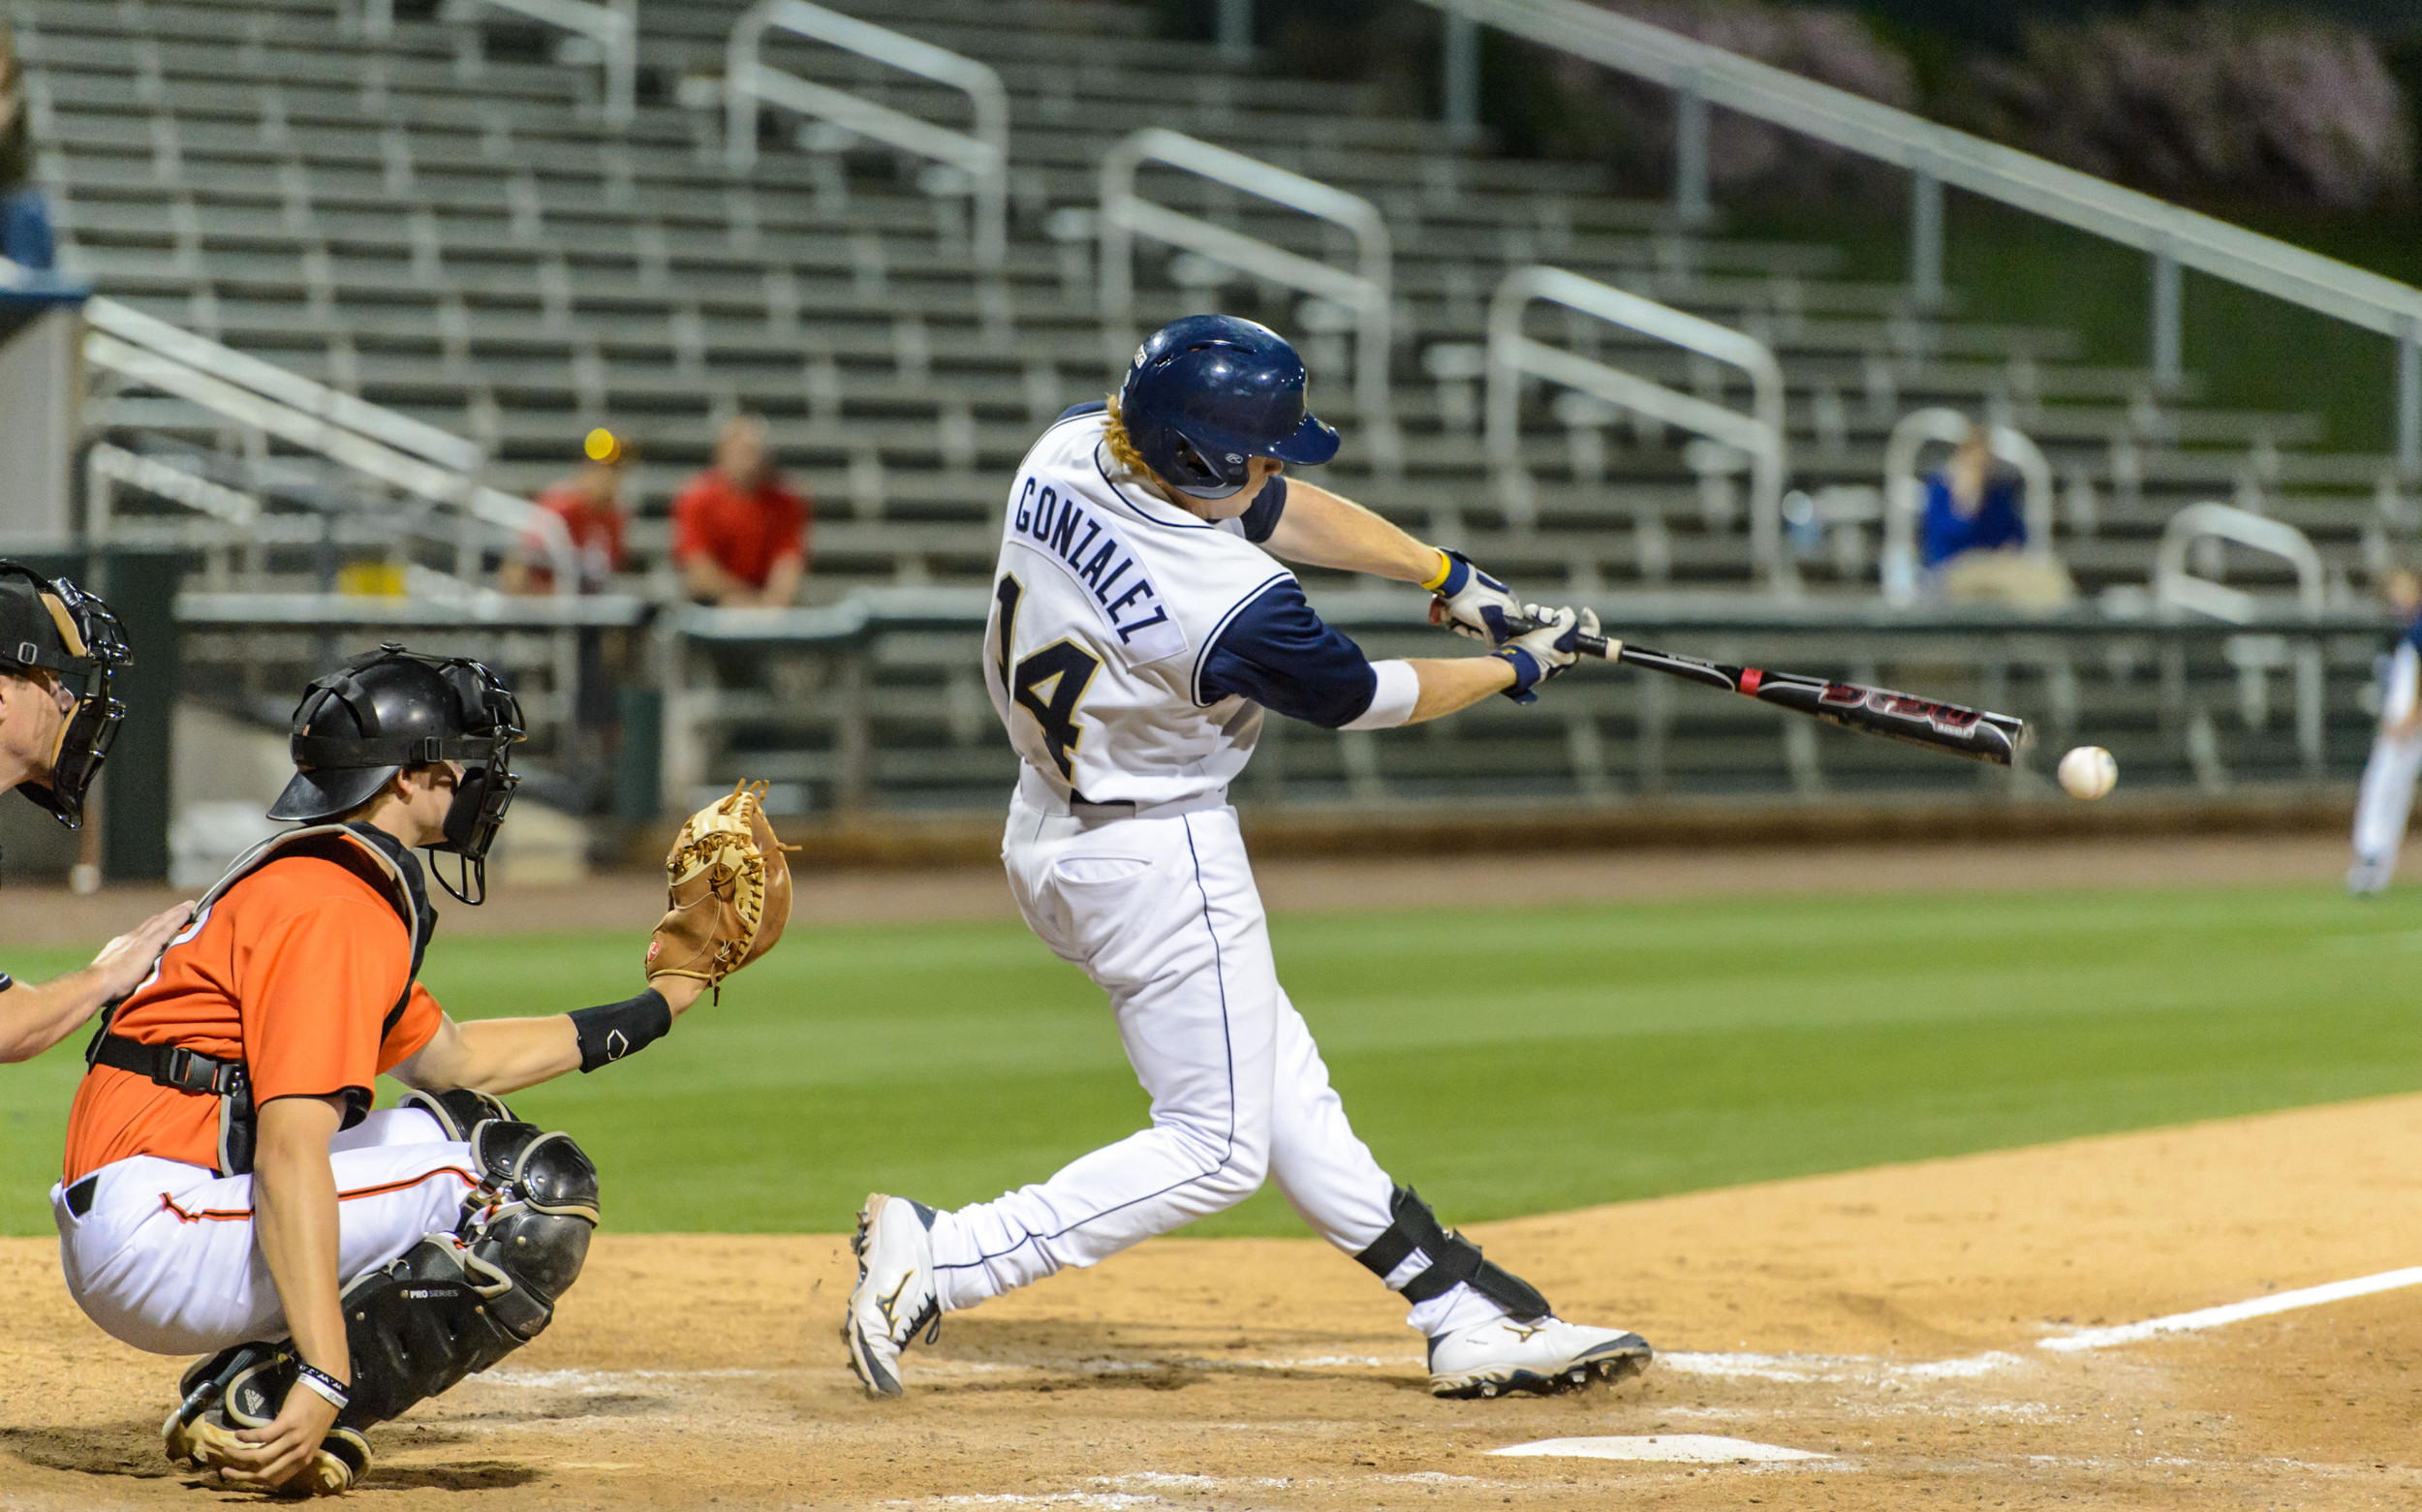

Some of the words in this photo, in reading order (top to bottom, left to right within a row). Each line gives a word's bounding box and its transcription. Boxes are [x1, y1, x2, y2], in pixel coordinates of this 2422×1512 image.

[1014, 476, 1169, 645] GONZALEZ
[995, 570, 1105, 787] 14
[409, 1289, 429, 1299] PRO
[429, 1289, 459, 1298] SERIES
